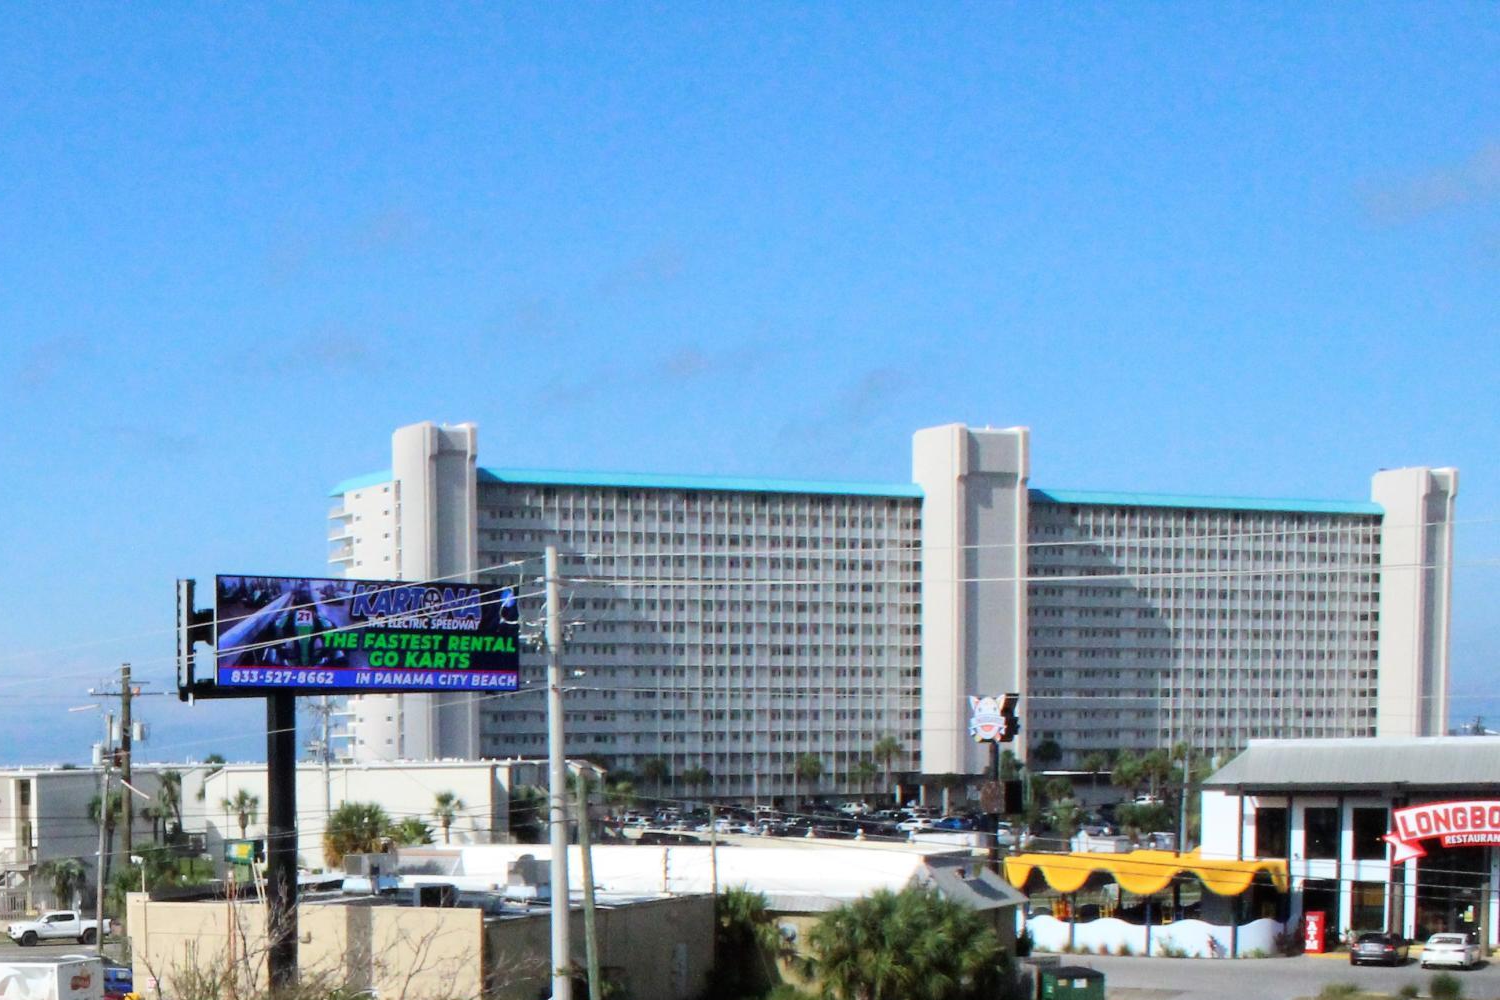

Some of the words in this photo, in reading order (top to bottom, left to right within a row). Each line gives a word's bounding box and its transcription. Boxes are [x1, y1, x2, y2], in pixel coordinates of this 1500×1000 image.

[388, 618, 428, 629] ELECTRIC
[430, 619, 481, 630] SPEEDWAY
[323, 633, 358, 648] THE
[364, 633, 443, 650] FASTEST
[448, 635, 515, 653] RENTAL
[369, 652, 399, 667] GO
[405, 652, 470, 669] KARTS
[231, 670, 334, 684] 833-527-8662
[356, 672, 372, 684] IN
[374, 673, 434, 685] PANAMA
[438, 674, 468, 686] CITY
[471, 674, 517, 687] BEACH
[1399, 806, 1500, 838] LONGBO
[1305, 920, 1318, 950] ATM
